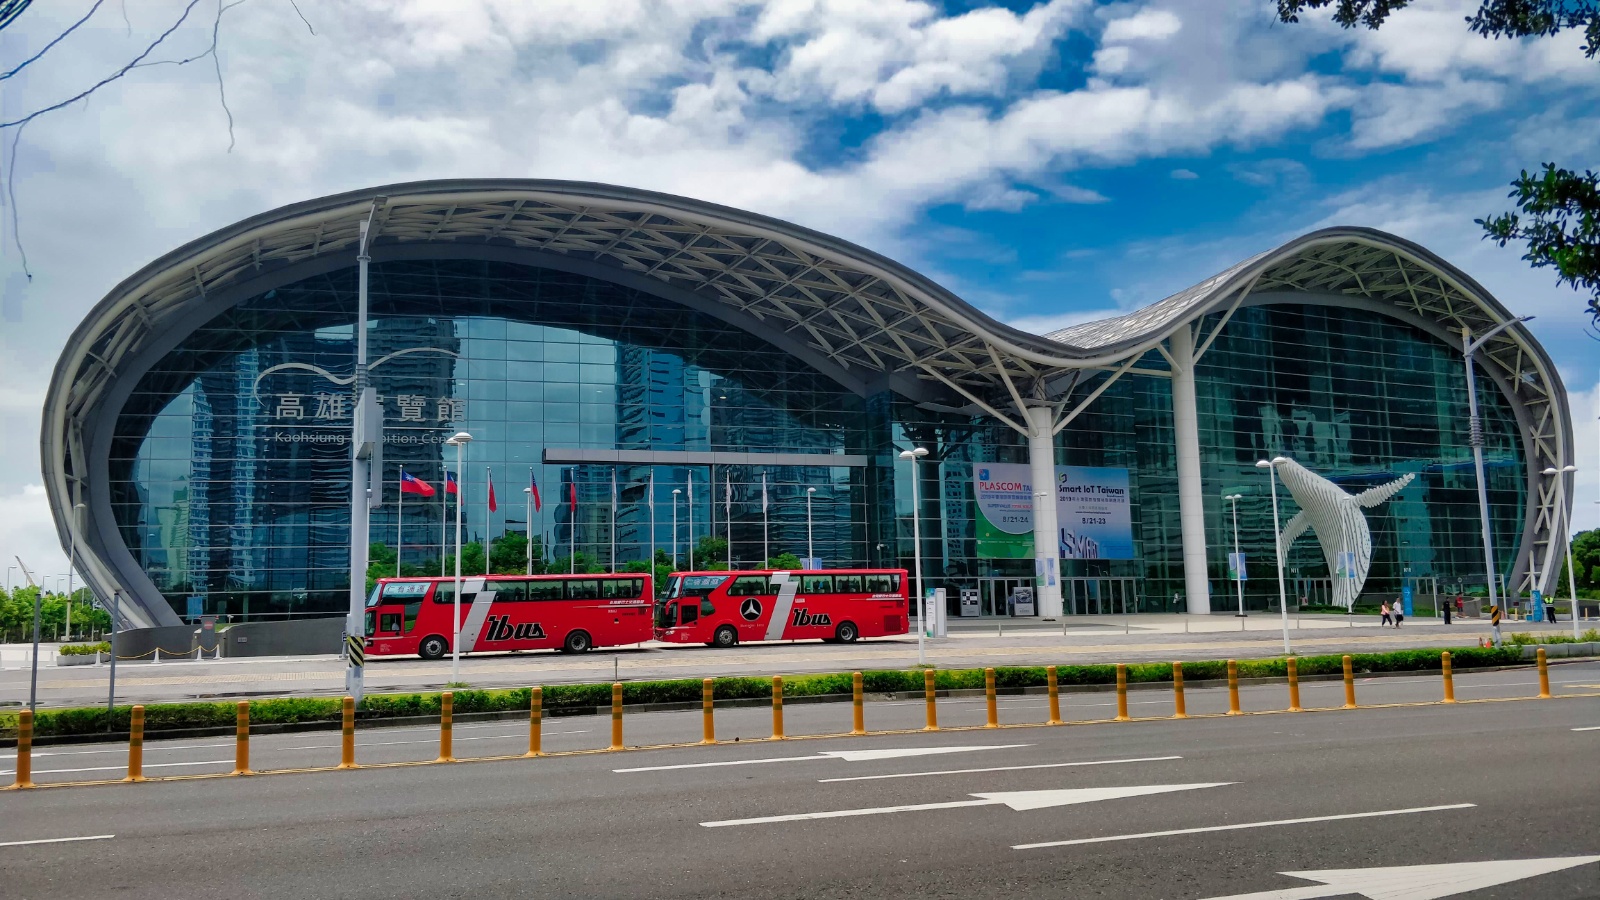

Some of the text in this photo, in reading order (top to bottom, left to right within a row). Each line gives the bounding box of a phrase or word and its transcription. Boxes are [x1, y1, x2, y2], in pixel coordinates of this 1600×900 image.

[275, 431, 345, 446] Kaohsiung
[422, 433, 448, 444] Cen
[979, 481, 1022, 491] PLASCOM
[1058, 484, 1125, 495] Smart IoT Taiwan
